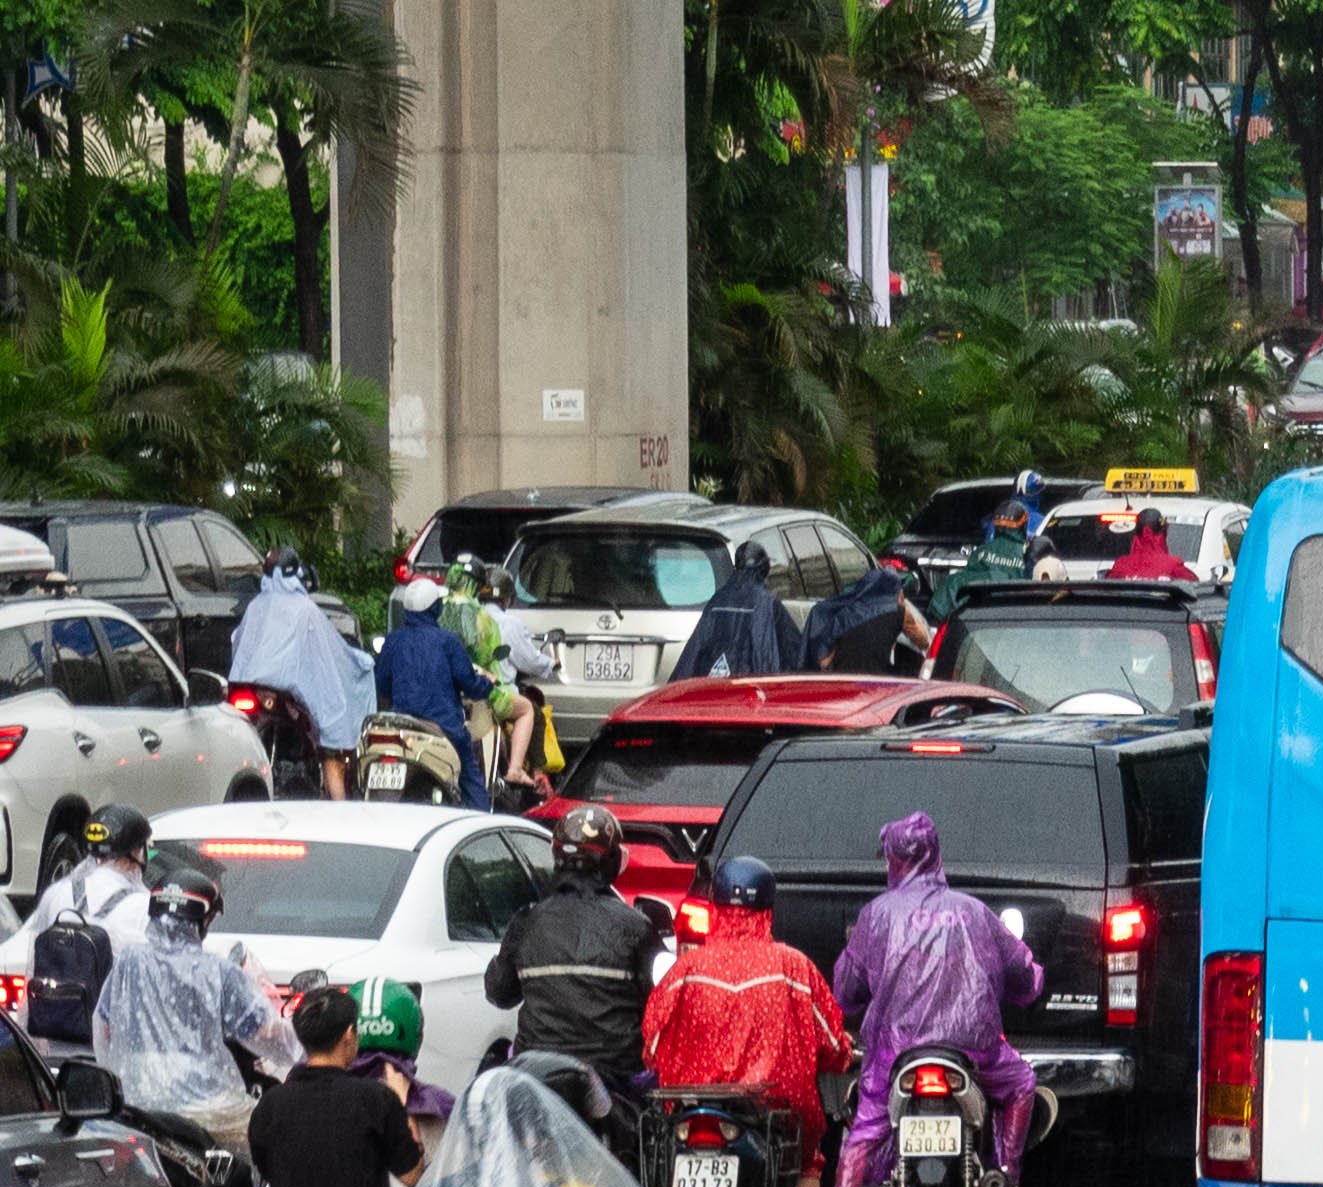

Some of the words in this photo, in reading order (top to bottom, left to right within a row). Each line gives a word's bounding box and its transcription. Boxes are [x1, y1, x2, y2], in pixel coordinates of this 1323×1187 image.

[639, 434, 669, 470] ER20
[596, 645, 621, 661] 29A
[586, 661, 631, 679] 536.52
[910, 1119, 951, 1136] 29-X7
[904, 1136, 957, 1153] 630.03
[687, 1159, 730, 1177] 17-B3
